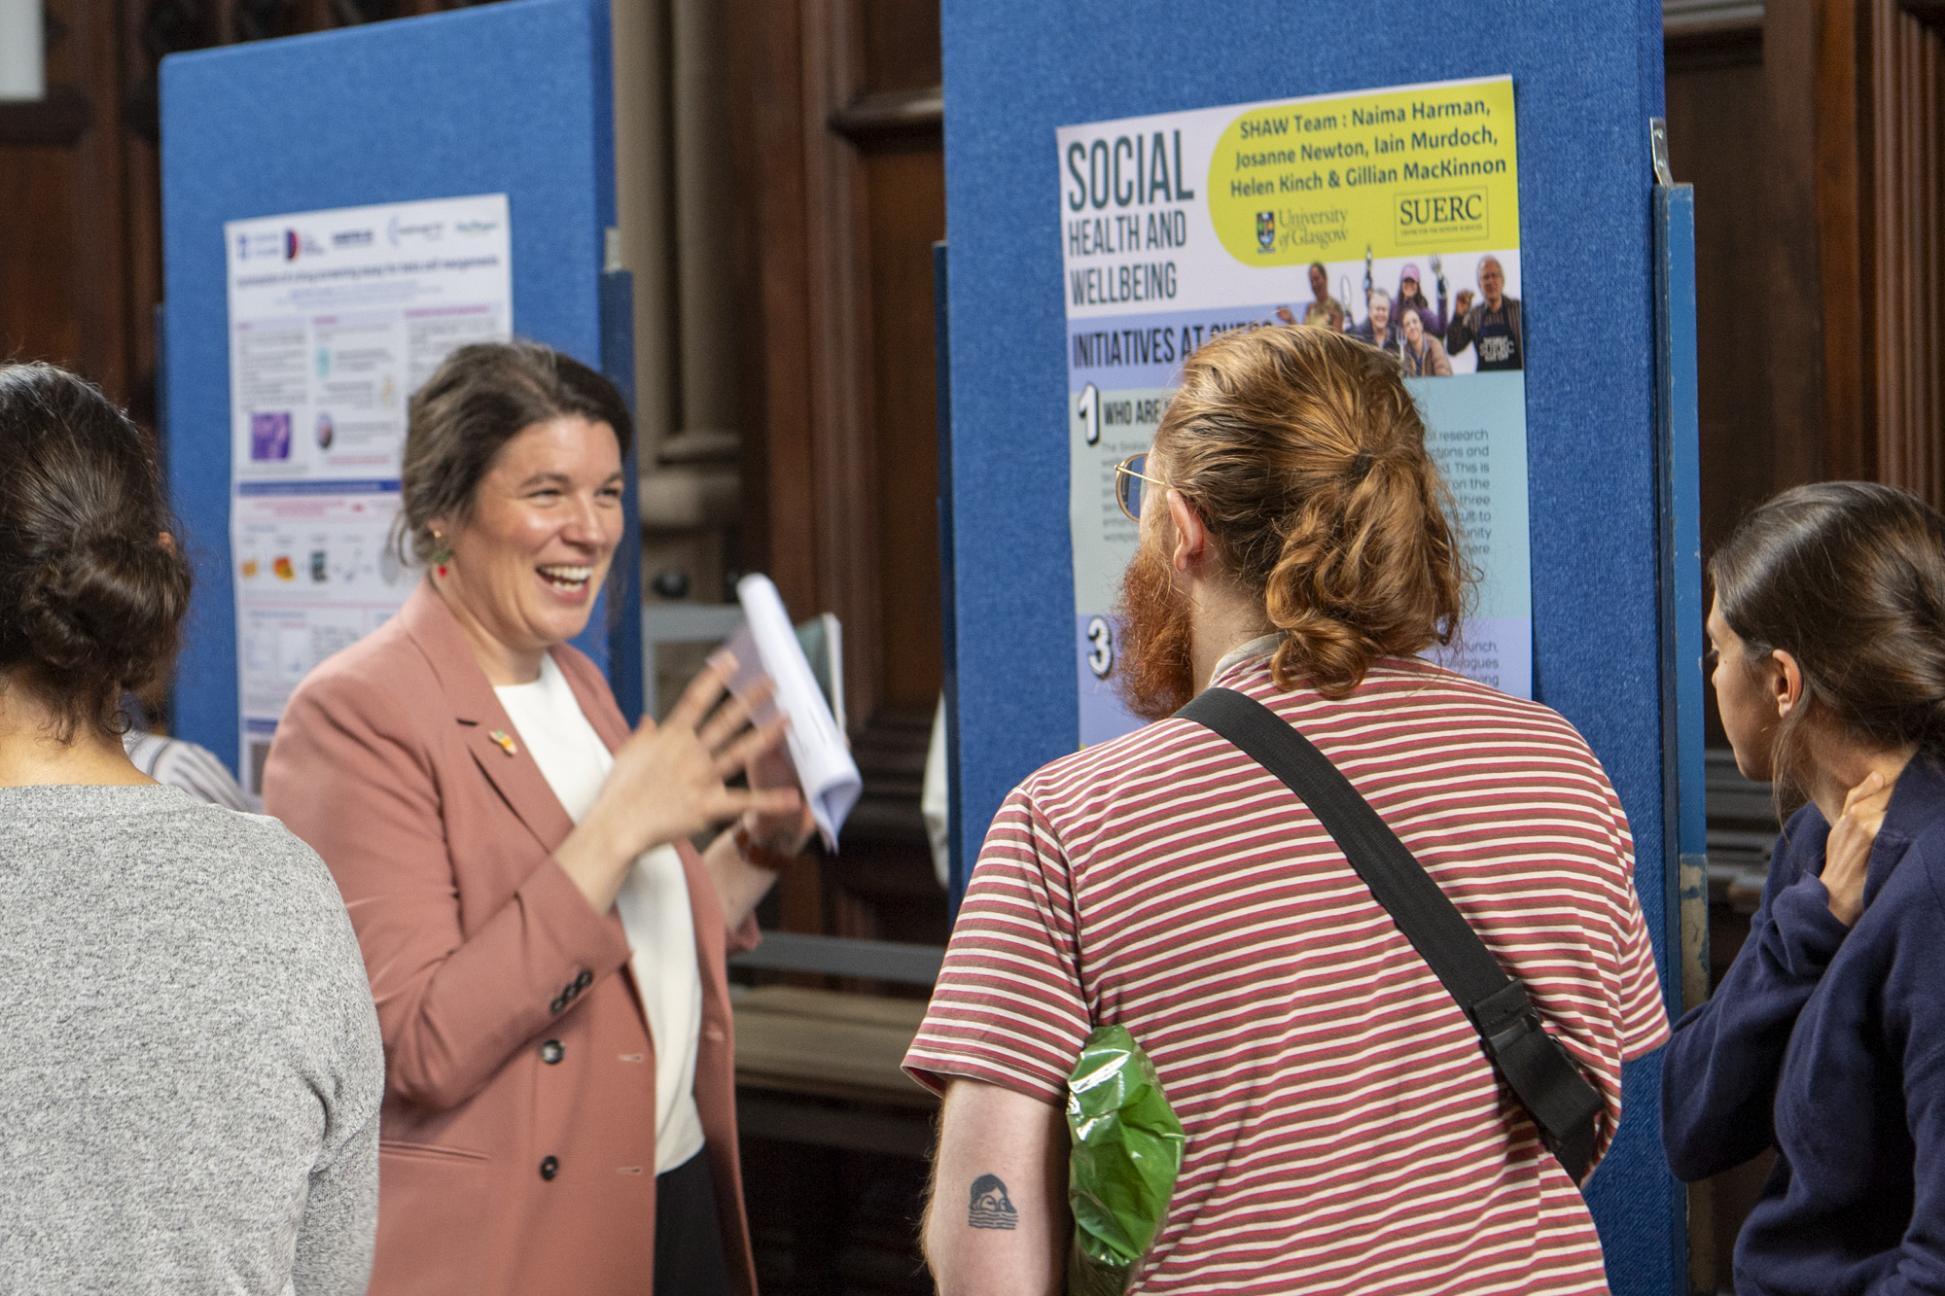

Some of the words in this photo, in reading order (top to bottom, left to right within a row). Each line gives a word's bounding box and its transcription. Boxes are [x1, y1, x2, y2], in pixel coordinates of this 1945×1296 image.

[1239, 117, 1289, 140] SHAW
[1294, 113, 1337, 135] Team
[1352, 105, 1406, 126] Naima
[1412, 99, 1491, 121] Harman,
[1235, 150, 1296, 171] Josanne
[1301, 141, 1369, 161] Newton,
[1374, 136, 1405, 155] Iain
[1411, 124, 1498, 148] Murdoch,
[1067, 129, 1194, 212] SOCIAL
[1231, 179, 1274, 198] Helen
[1280, 171, 1323, 192] Kinch
[1328, 172, 1341, 189] &
[1346, 164, 1398, 186] Gillian
[1403, 157, 1507, 181] MacKinnon
[1279, 207, 1349, 229] University
[1400, 194, 1482, 226] SUERC
[1068, 214, 1140, 258] HEALTH
[1146, 209, 1187, 250] AND
[1291, 228, 1349, 250] Glasgow
[1070, 261, 1177, 307] WELLBEING
[1073, 327, 1175, 369] INITIATIVES
[1079, 382, 1099, 447] 1
[1103, 401, 1132, 426] WHO
[1136, 400, 1159, 425] ARE
[1440, 427, 1489, 442] research
[1454, 462, 1477, 474] This
[1466, 445, 1490, 458] and
[1470, 478, 1490, 490] the
[1088, 615, 1113, 680] 3
